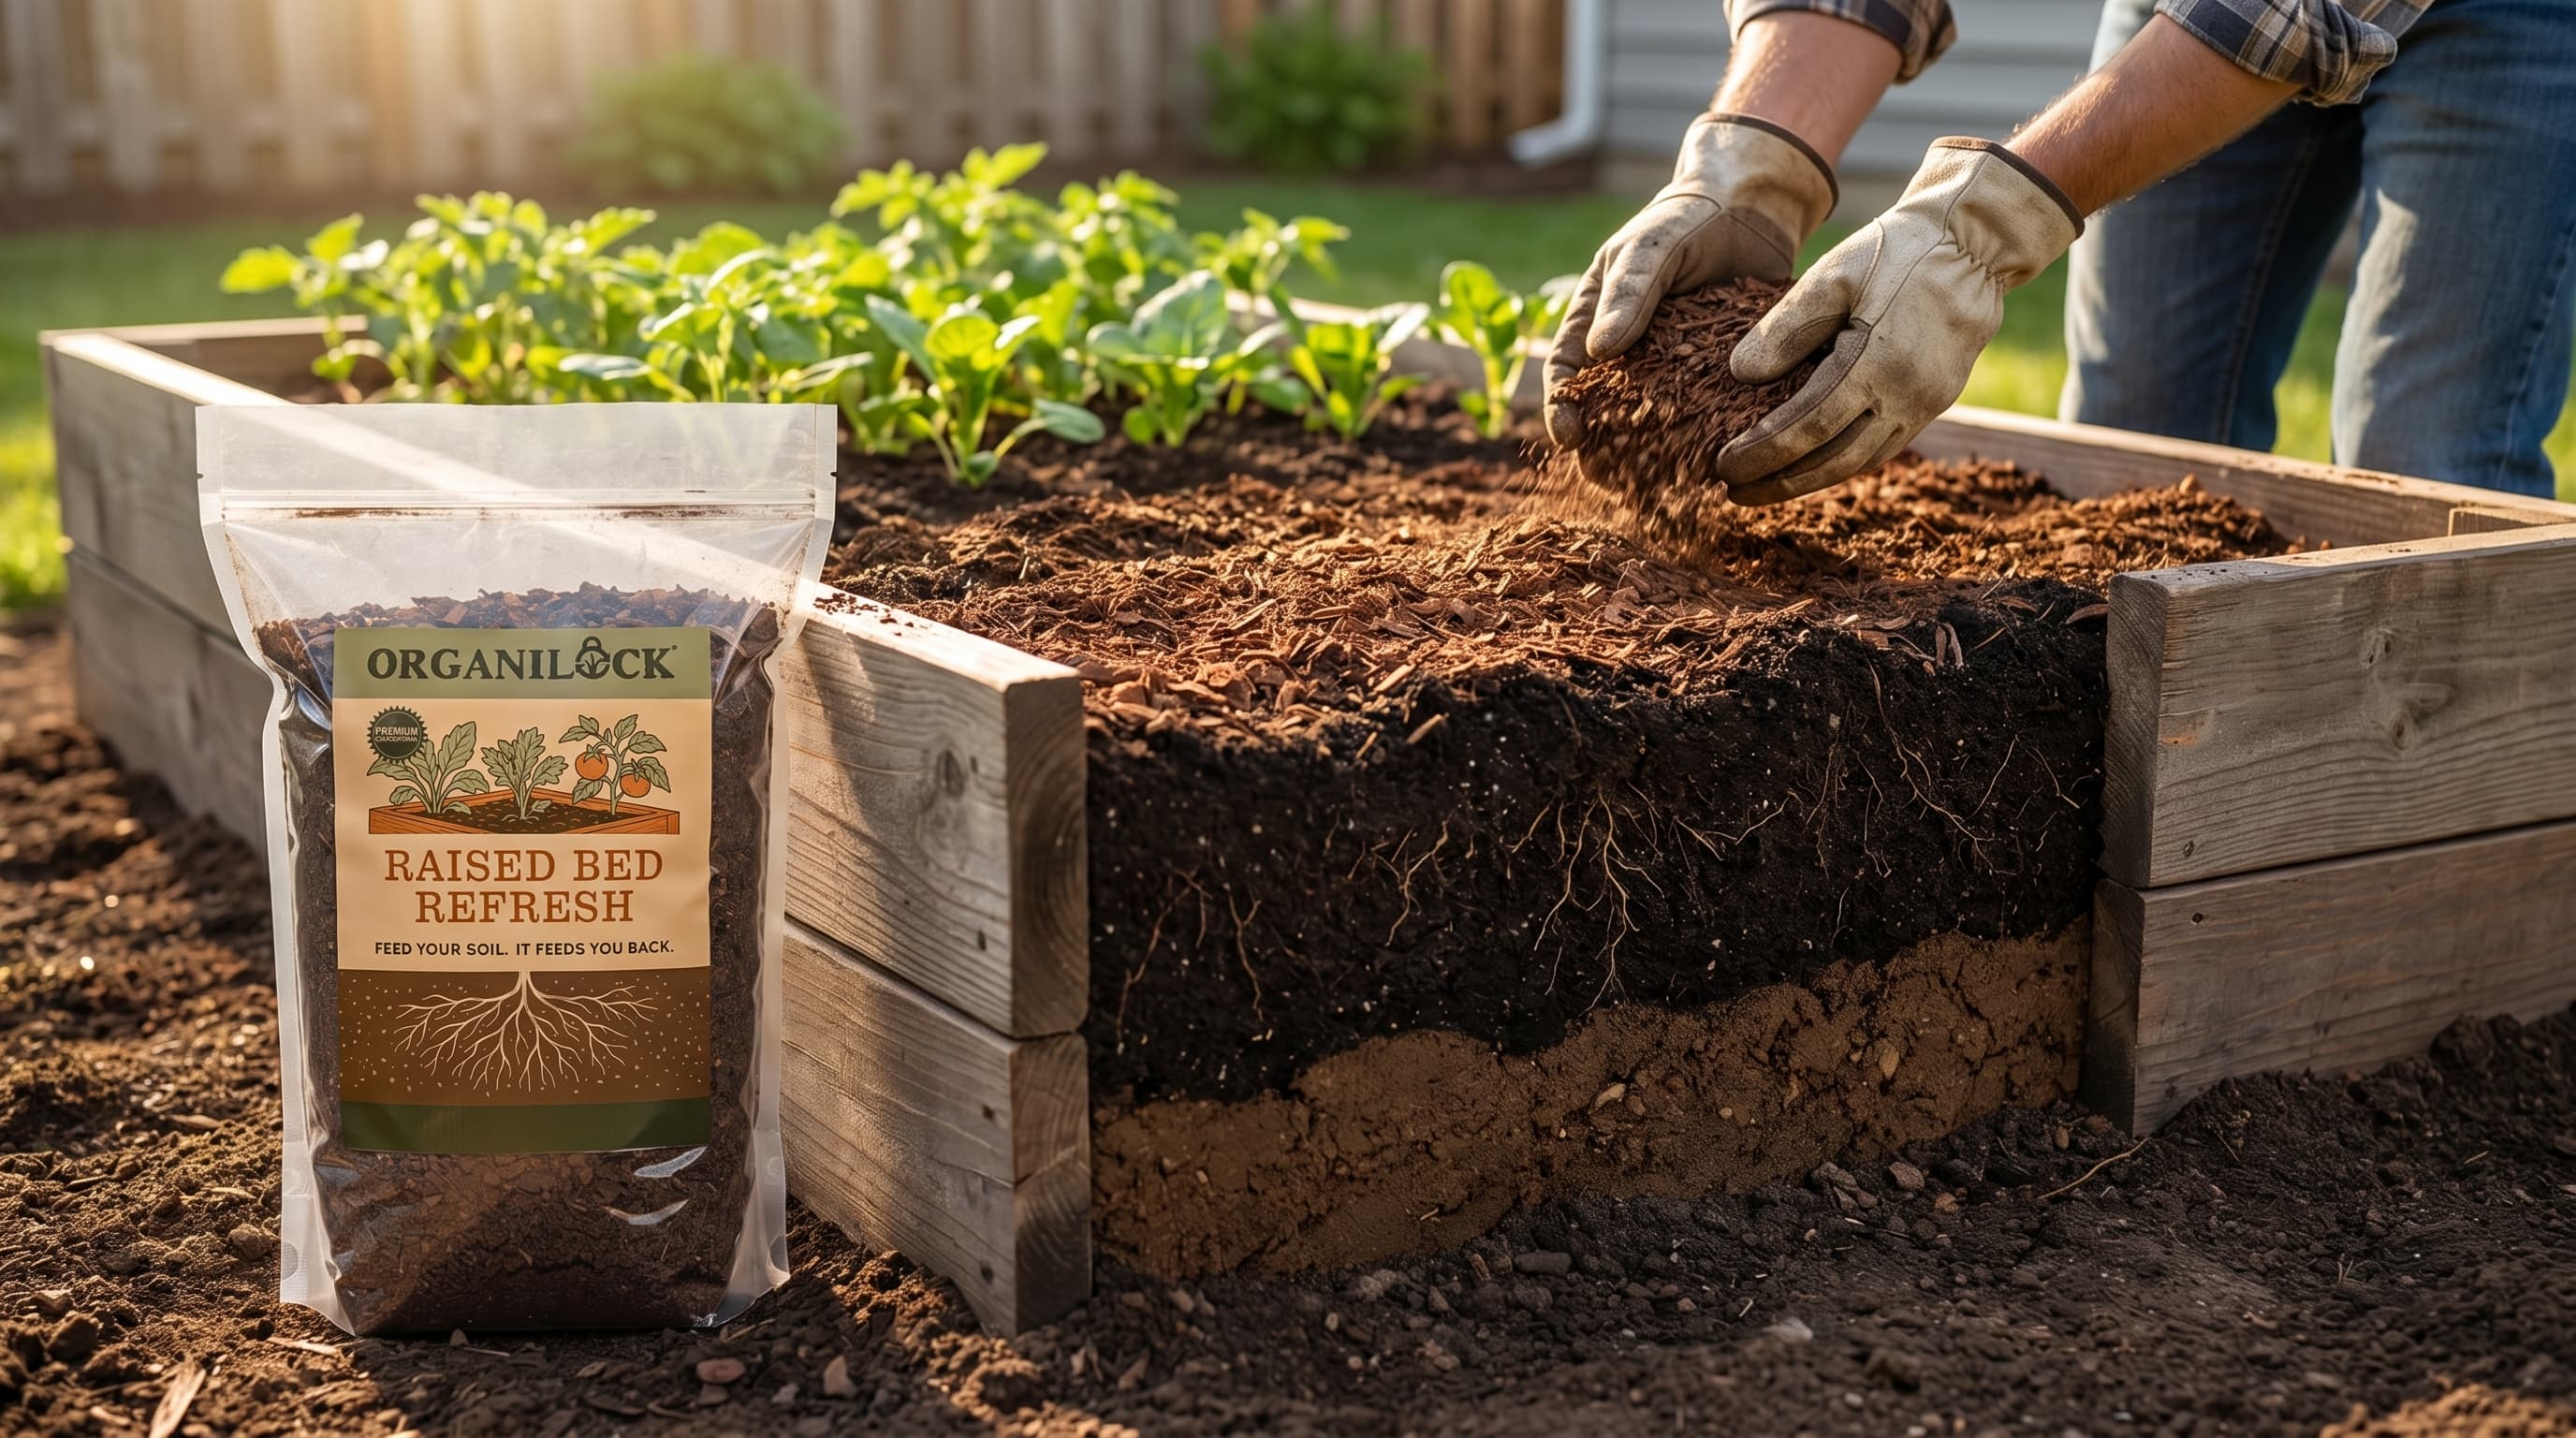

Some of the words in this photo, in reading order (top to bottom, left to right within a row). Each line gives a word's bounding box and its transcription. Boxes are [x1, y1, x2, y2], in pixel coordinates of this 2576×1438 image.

[375, 726, 418, 736] PREMIUM
[384, 849, 555, 882] RAISED
[573, 849, 663, 882] BED
[415, 889, 634, 923] REFRESH
[374, 942, 412, 955] FEED
[417, 943, 461, 956] YOUR
[466, 943, 508, 956] SOIL.
[516, 943, 531, 956] IT
[535, 942, 585, 956] FEEDS
[590, 942, 623, 955] YOU
[628, 939, 674, 955] BACK.
